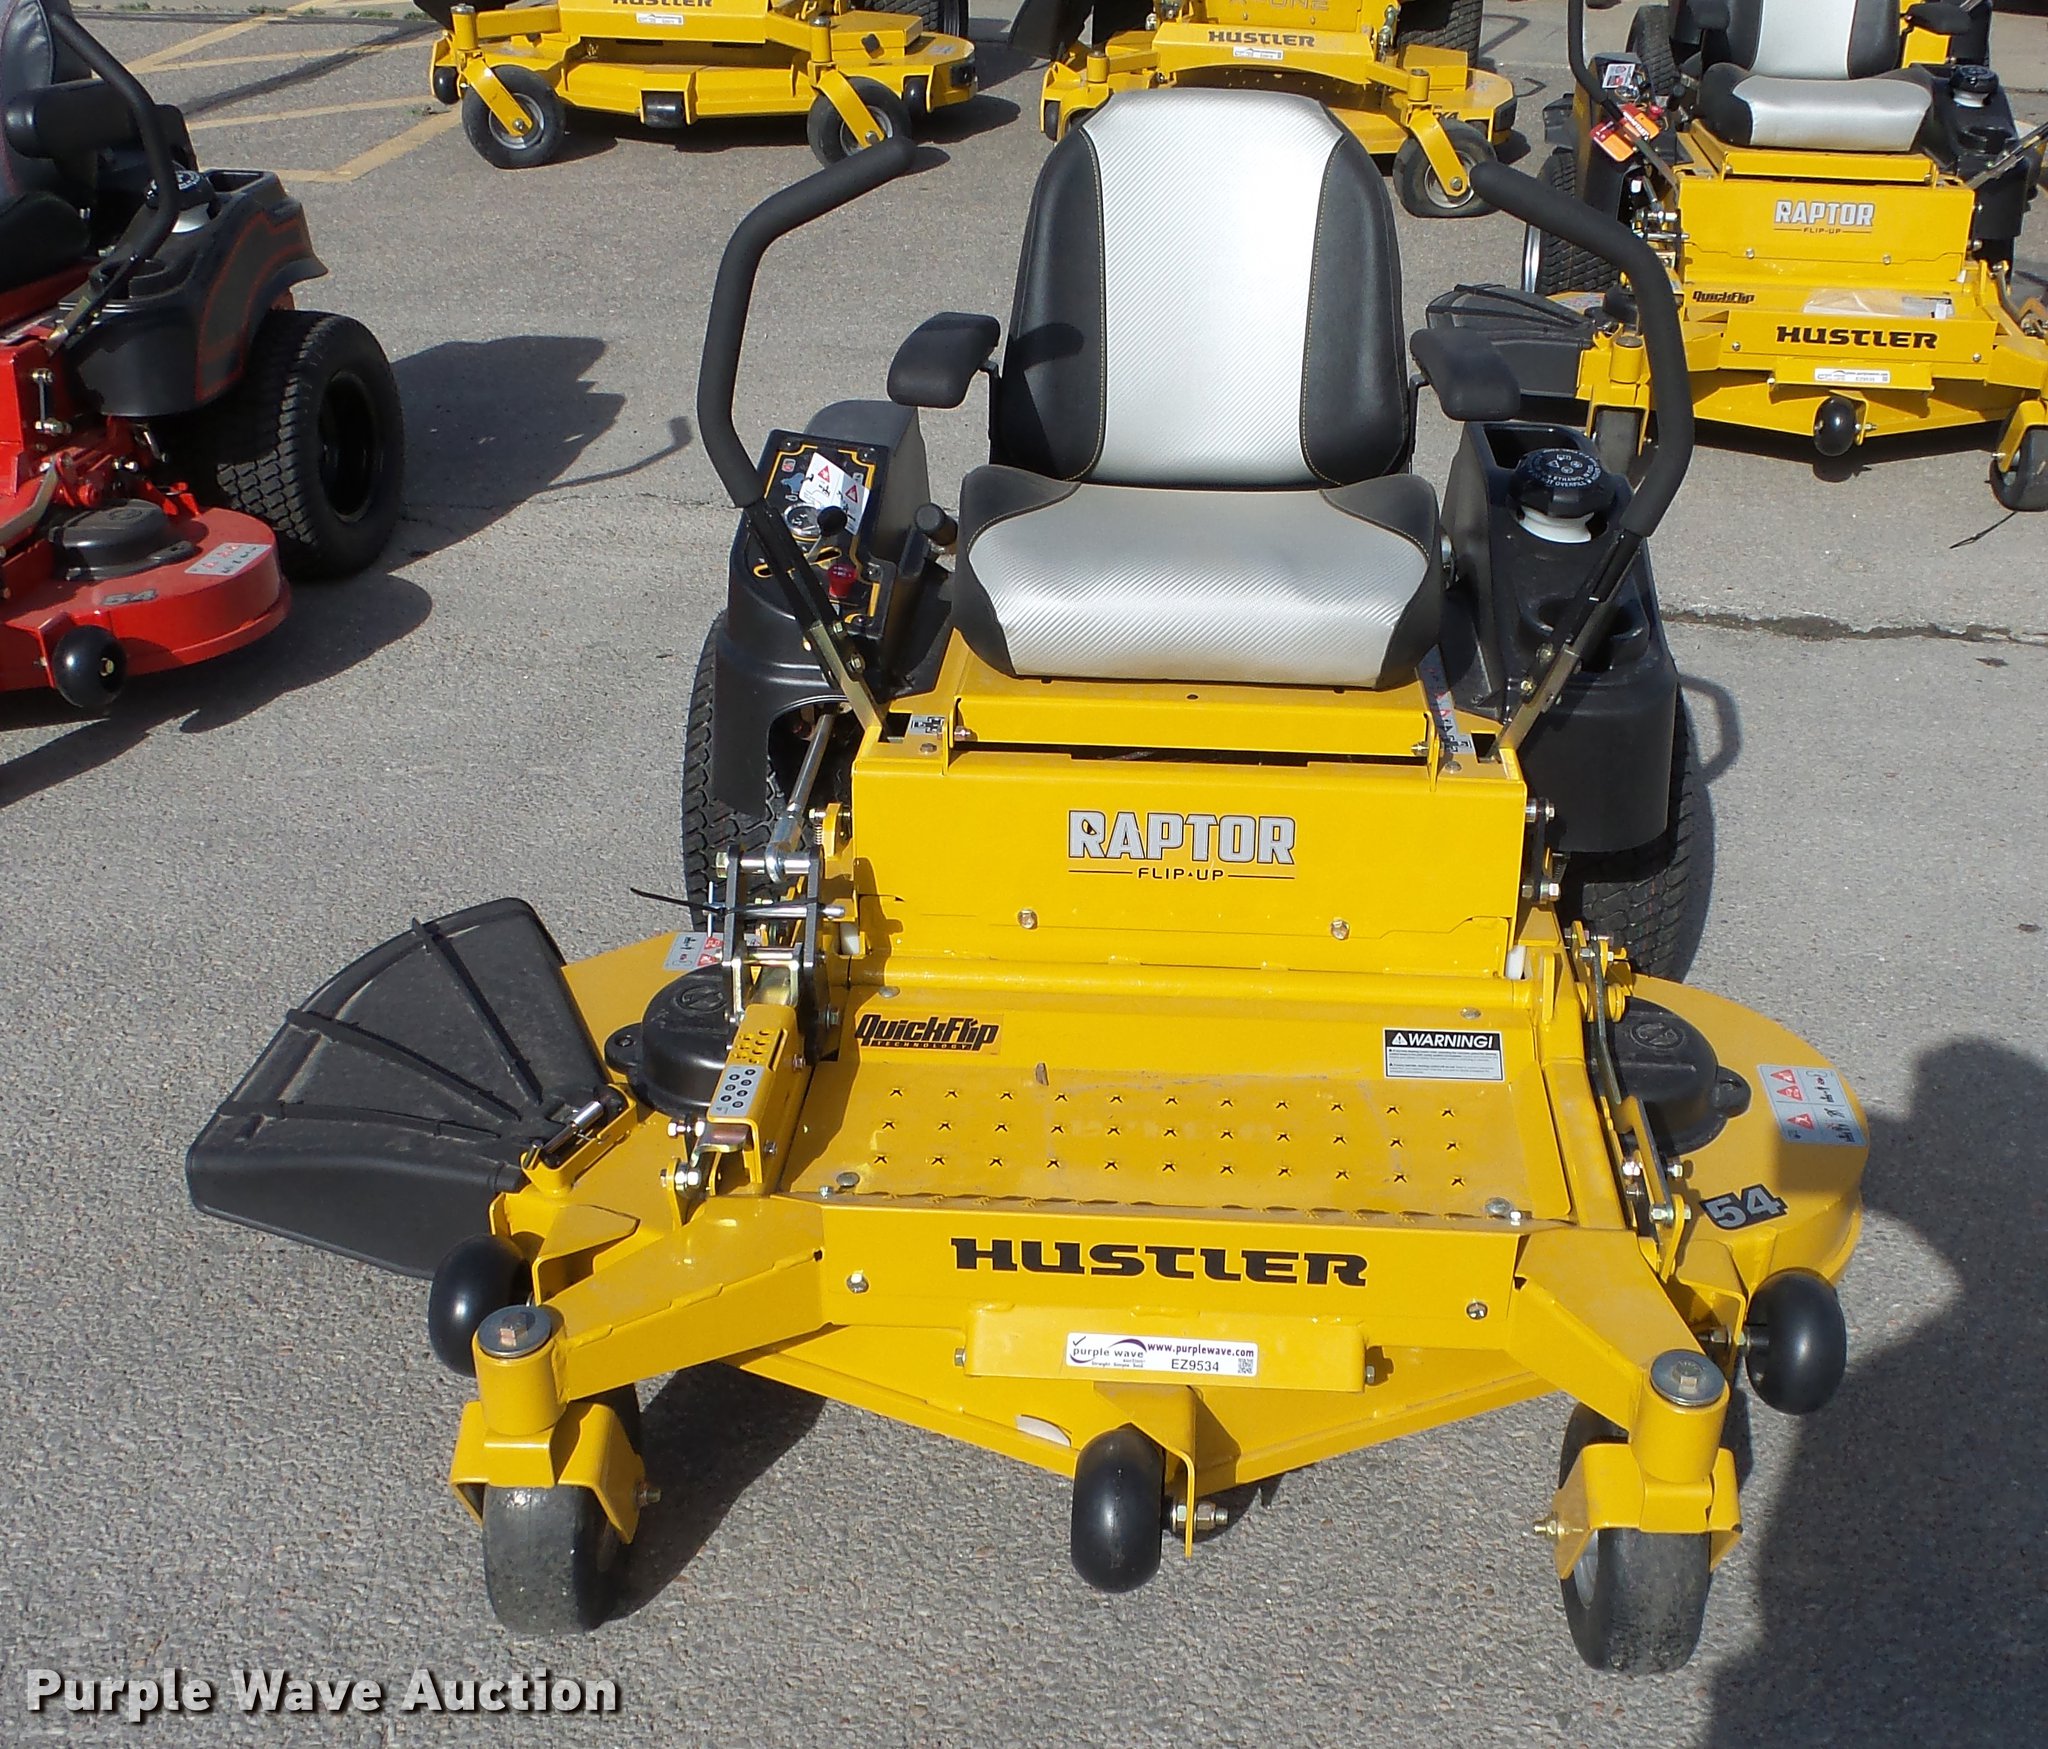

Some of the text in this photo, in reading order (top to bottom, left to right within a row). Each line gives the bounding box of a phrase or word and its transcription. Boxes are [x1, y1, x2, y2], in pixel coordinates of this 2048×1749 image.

[1208, 31, 1315, 47] HUSTLER
[1774, 200, 1876, 226] RAPTOR
[1776, 326, 1938, 349] HUSTLER
[102, 589, 158, 606] 54
[1069, 810, 1295, 864] RAPTOR
[854, 1013, 999, 1051] QuickFlip
[877, 1041, 967, 1049] TECHNOLOGY
[1408, 1033, 1494, 1049] WARNING!
[1701, 1185, 1786, 1230] 54
[950, 1237, 1368, 1287] HUSTLER
[1073, 1347, 1144, 1358] purple wave
[1148, 1343, 1254, 1357] www.purplewave.com
[1171, 1359, 1219, 1372] EZ9534
